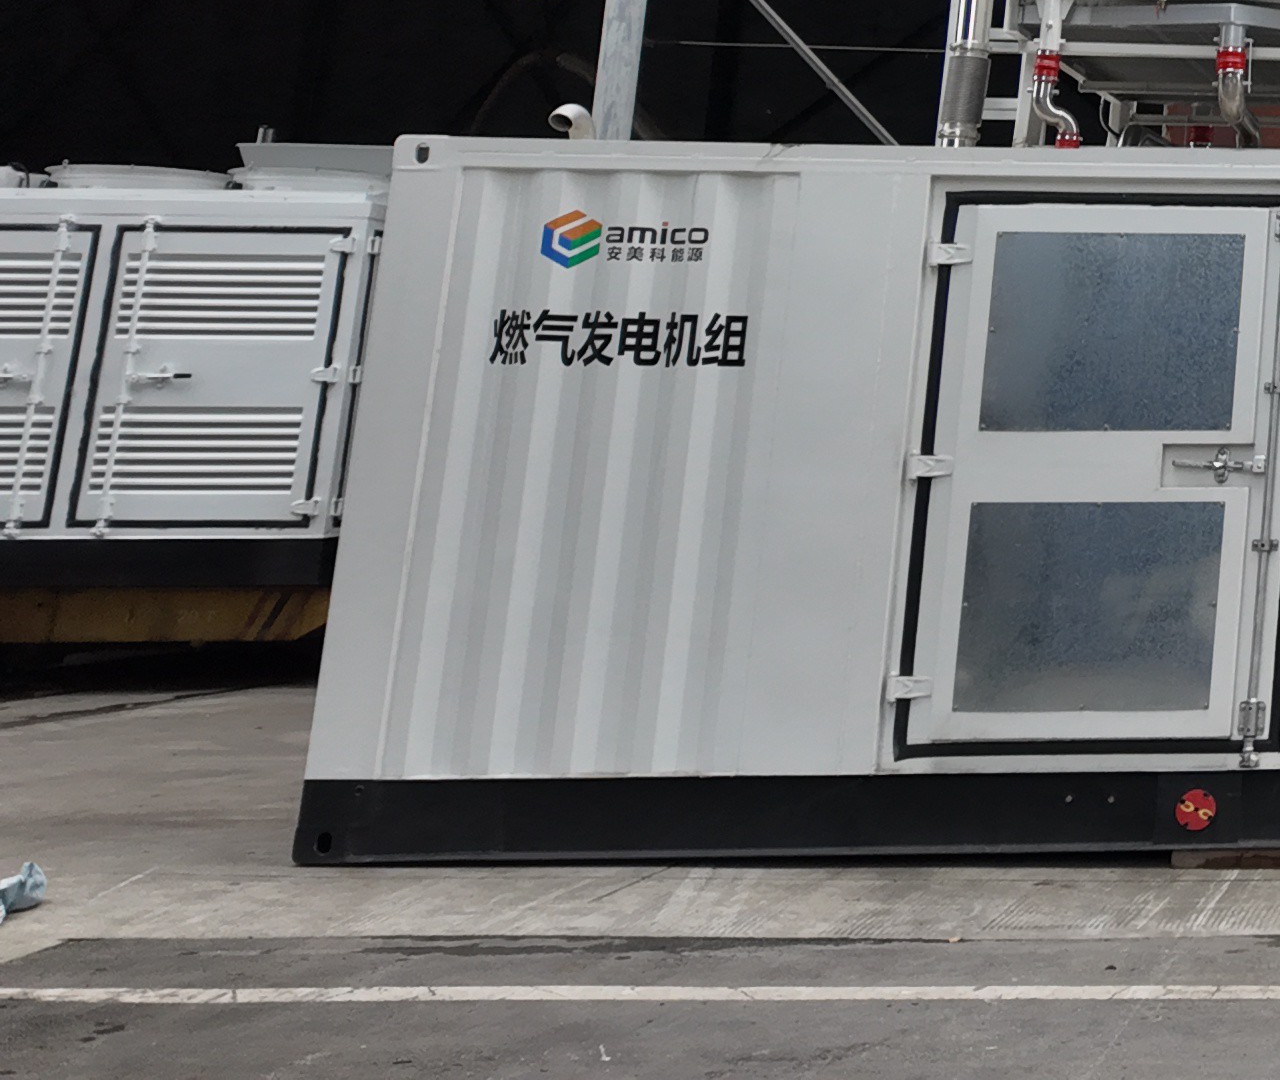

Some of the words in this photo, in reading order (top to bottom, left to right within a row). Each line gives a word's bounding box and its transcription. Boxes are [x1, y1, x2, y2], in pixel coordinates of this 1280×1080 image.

[605, 221, 709, 245] amico
[606, 246, 704, 263] 安美科能源
[489, 309, 749, 368] 燃气发电机组
